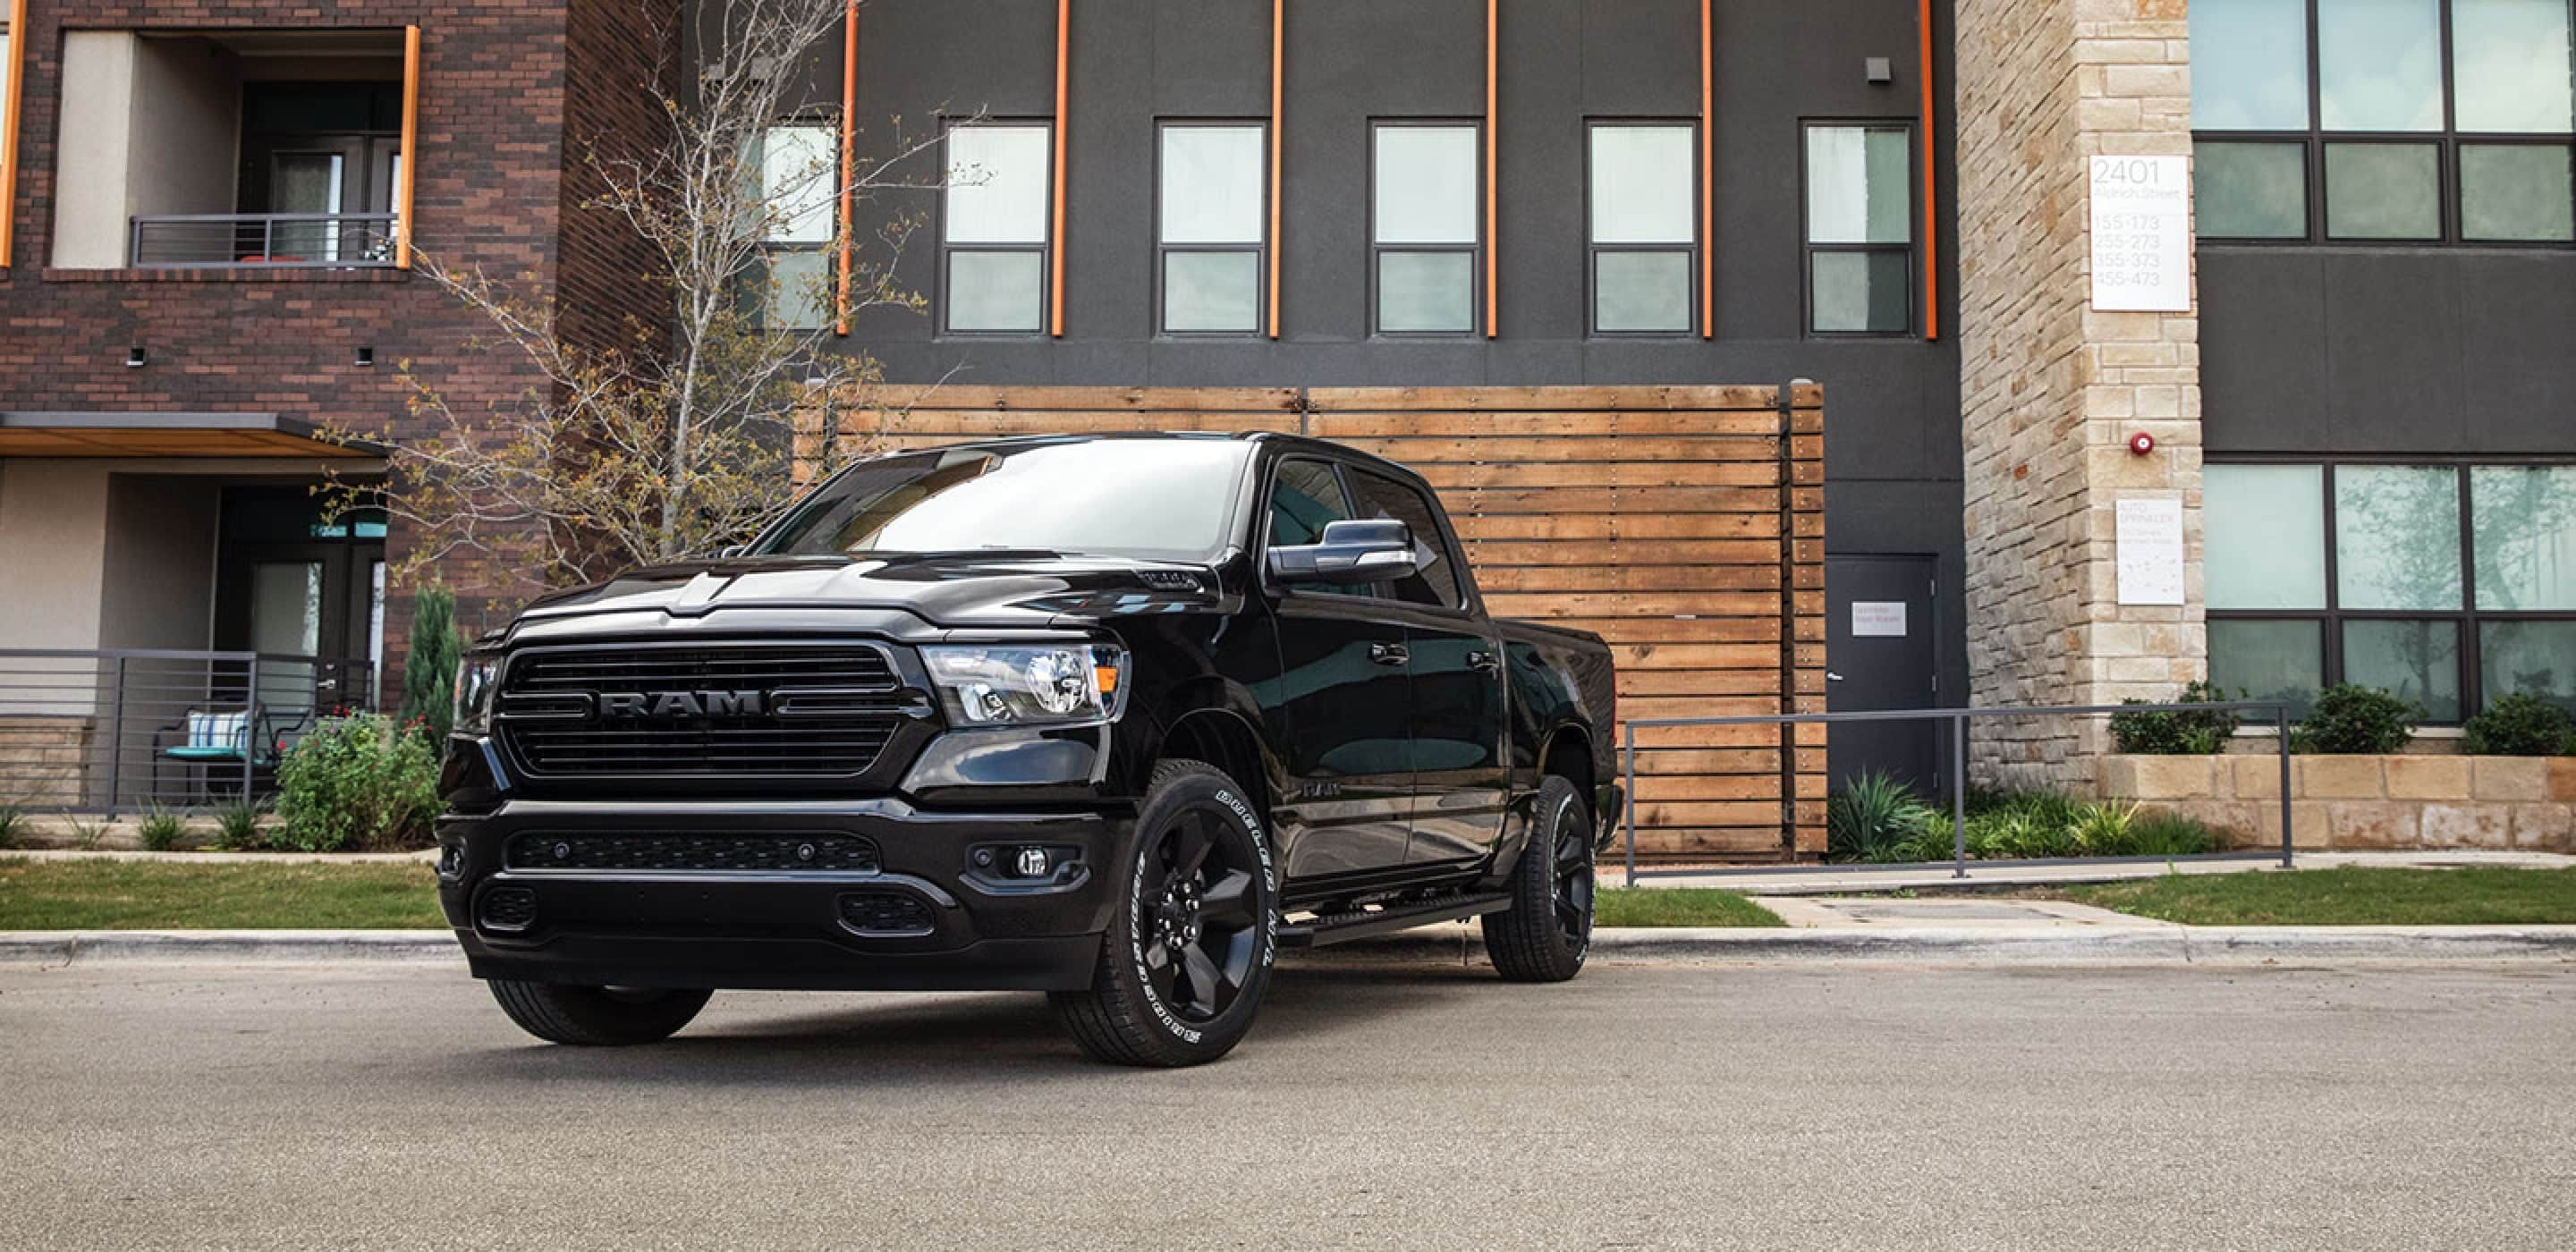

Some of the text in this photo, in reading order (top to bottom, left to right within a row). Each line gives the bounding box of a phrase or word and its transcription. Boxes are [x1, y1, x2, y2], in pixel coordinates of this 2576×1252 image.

[2094, 159, 2159, 184] 2401
[2095, 215, 2160, 230] 155-173
[2095, 233, 2160, 249] 255-273
[2095, 252, 2160, 267] 355-373
[2095, 271, 2160, 286] 455-473
[599, 689, 763, 716] RAM
